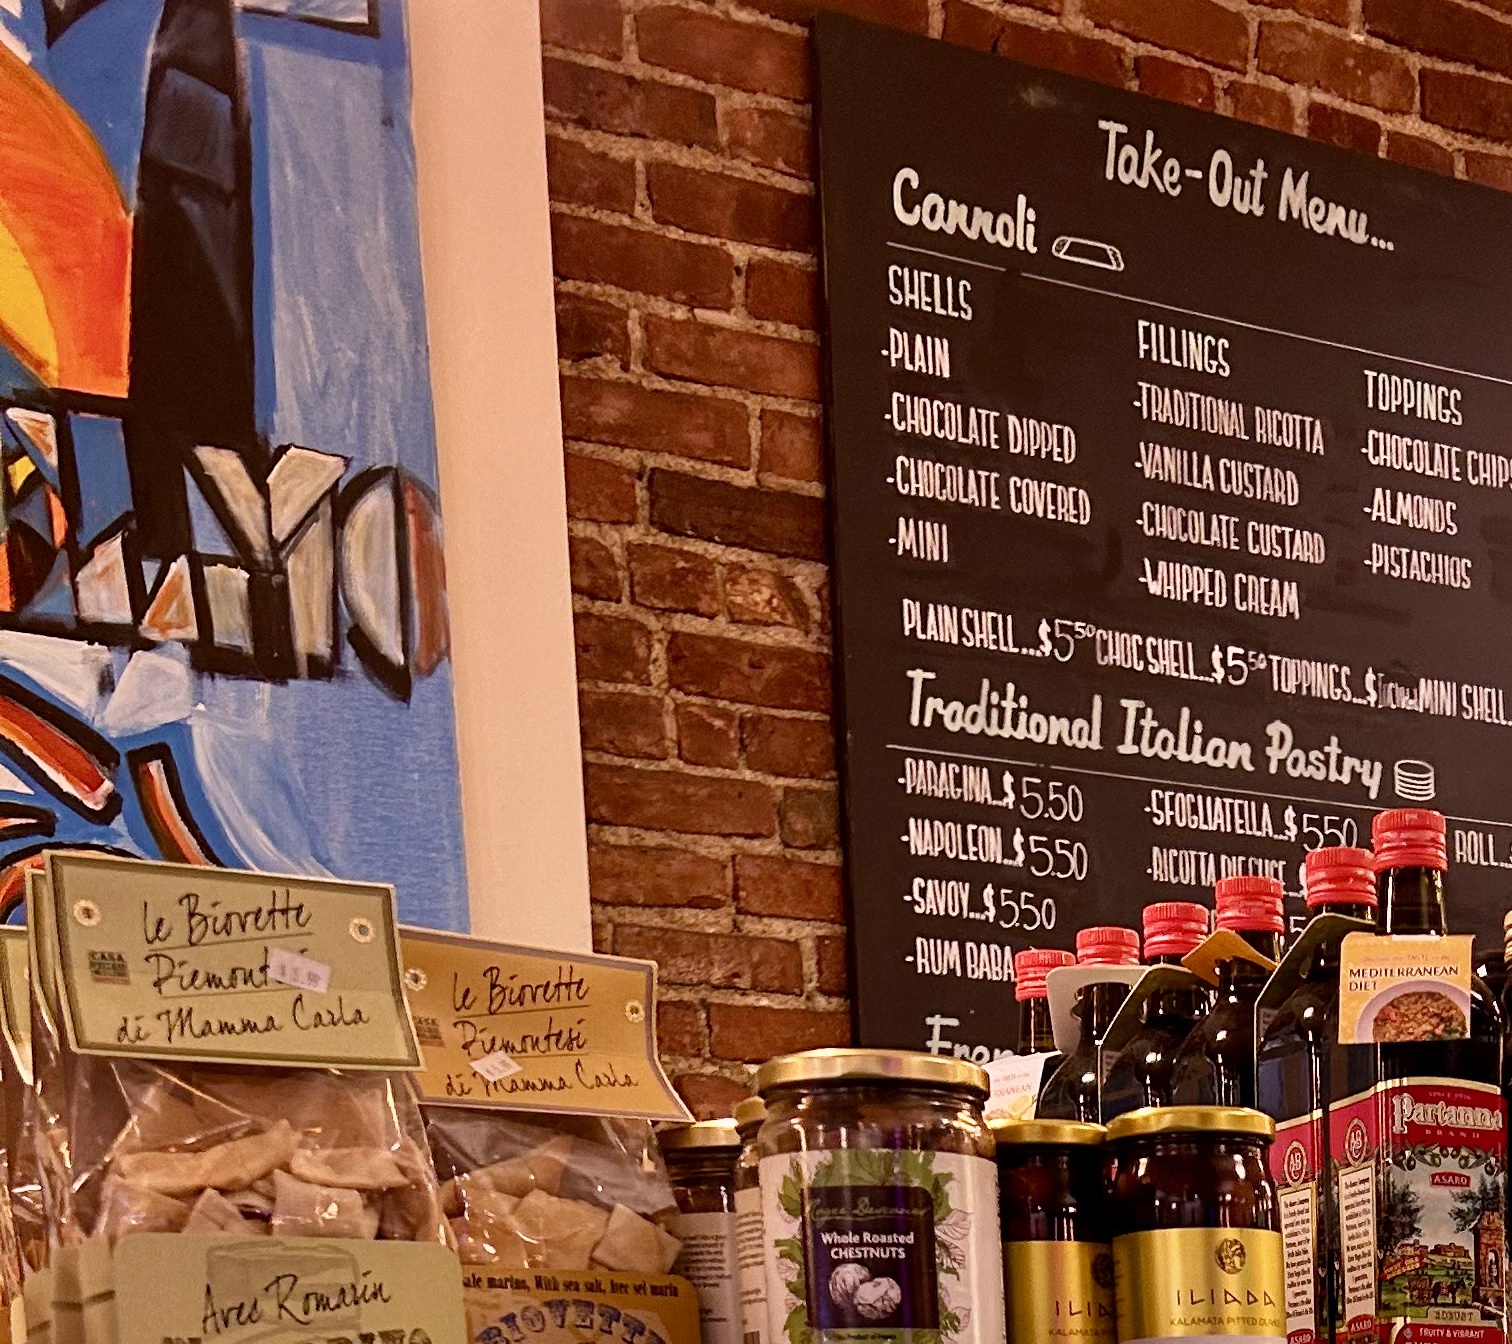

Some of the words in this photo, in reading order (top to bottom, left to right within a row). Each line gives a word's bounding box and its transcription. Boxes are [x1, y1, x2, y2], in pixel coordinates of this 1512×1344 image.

[1098, 119, 1268, 218] Take-Out
[893, 167, 1037, 255] Cannoli
[888, 265, 973, 321] SHELLS
[1138, 320, 1231, 379] FILLINGS
[1363, 370, 1463, 427] TOPPINGS
[1008, 415, 1076, 465] DIPPED
[1254, 405, 1325, 457] RICOTTA
[1009, 479, 1091, 527] COVERED
[1219, 459, 1299, 508] CUSTARD
[1247, 519, 1326, 565] CUSTARD
[1234, 572, 1299, 620] CREAM
[906, 669, 1103, 750] Traditional
[1117, 699, 1254, 772] Italian
[1265, 720, 1383, 800] Pastry
[1349, 965, 1459, 978] MEDITERRANEAN
[1349, 980, 1377, 992] DIET
[157, 1006, 284, 1043] Mamma
[293, 995, 369, 1030] Carla
[576, 1059, 639, 1090] Carla
[1392, 1092, 1503, 1134] Partanna
[1434, 1176, 1467, 1186] ASARO
[821, 1231, 860, 1245] Whole
[863, 1231, 914, 1245] Roasted
[831, 1247, 906, 1260] CHESTNUTS
[202, 1277, 262, 1336] Avec
[264, 1271, 393, 1316] Romarin
[1170, 1316, 1224, 1327] KALAMATA
[1176, 1289, 1276, 1307] ILIADA
